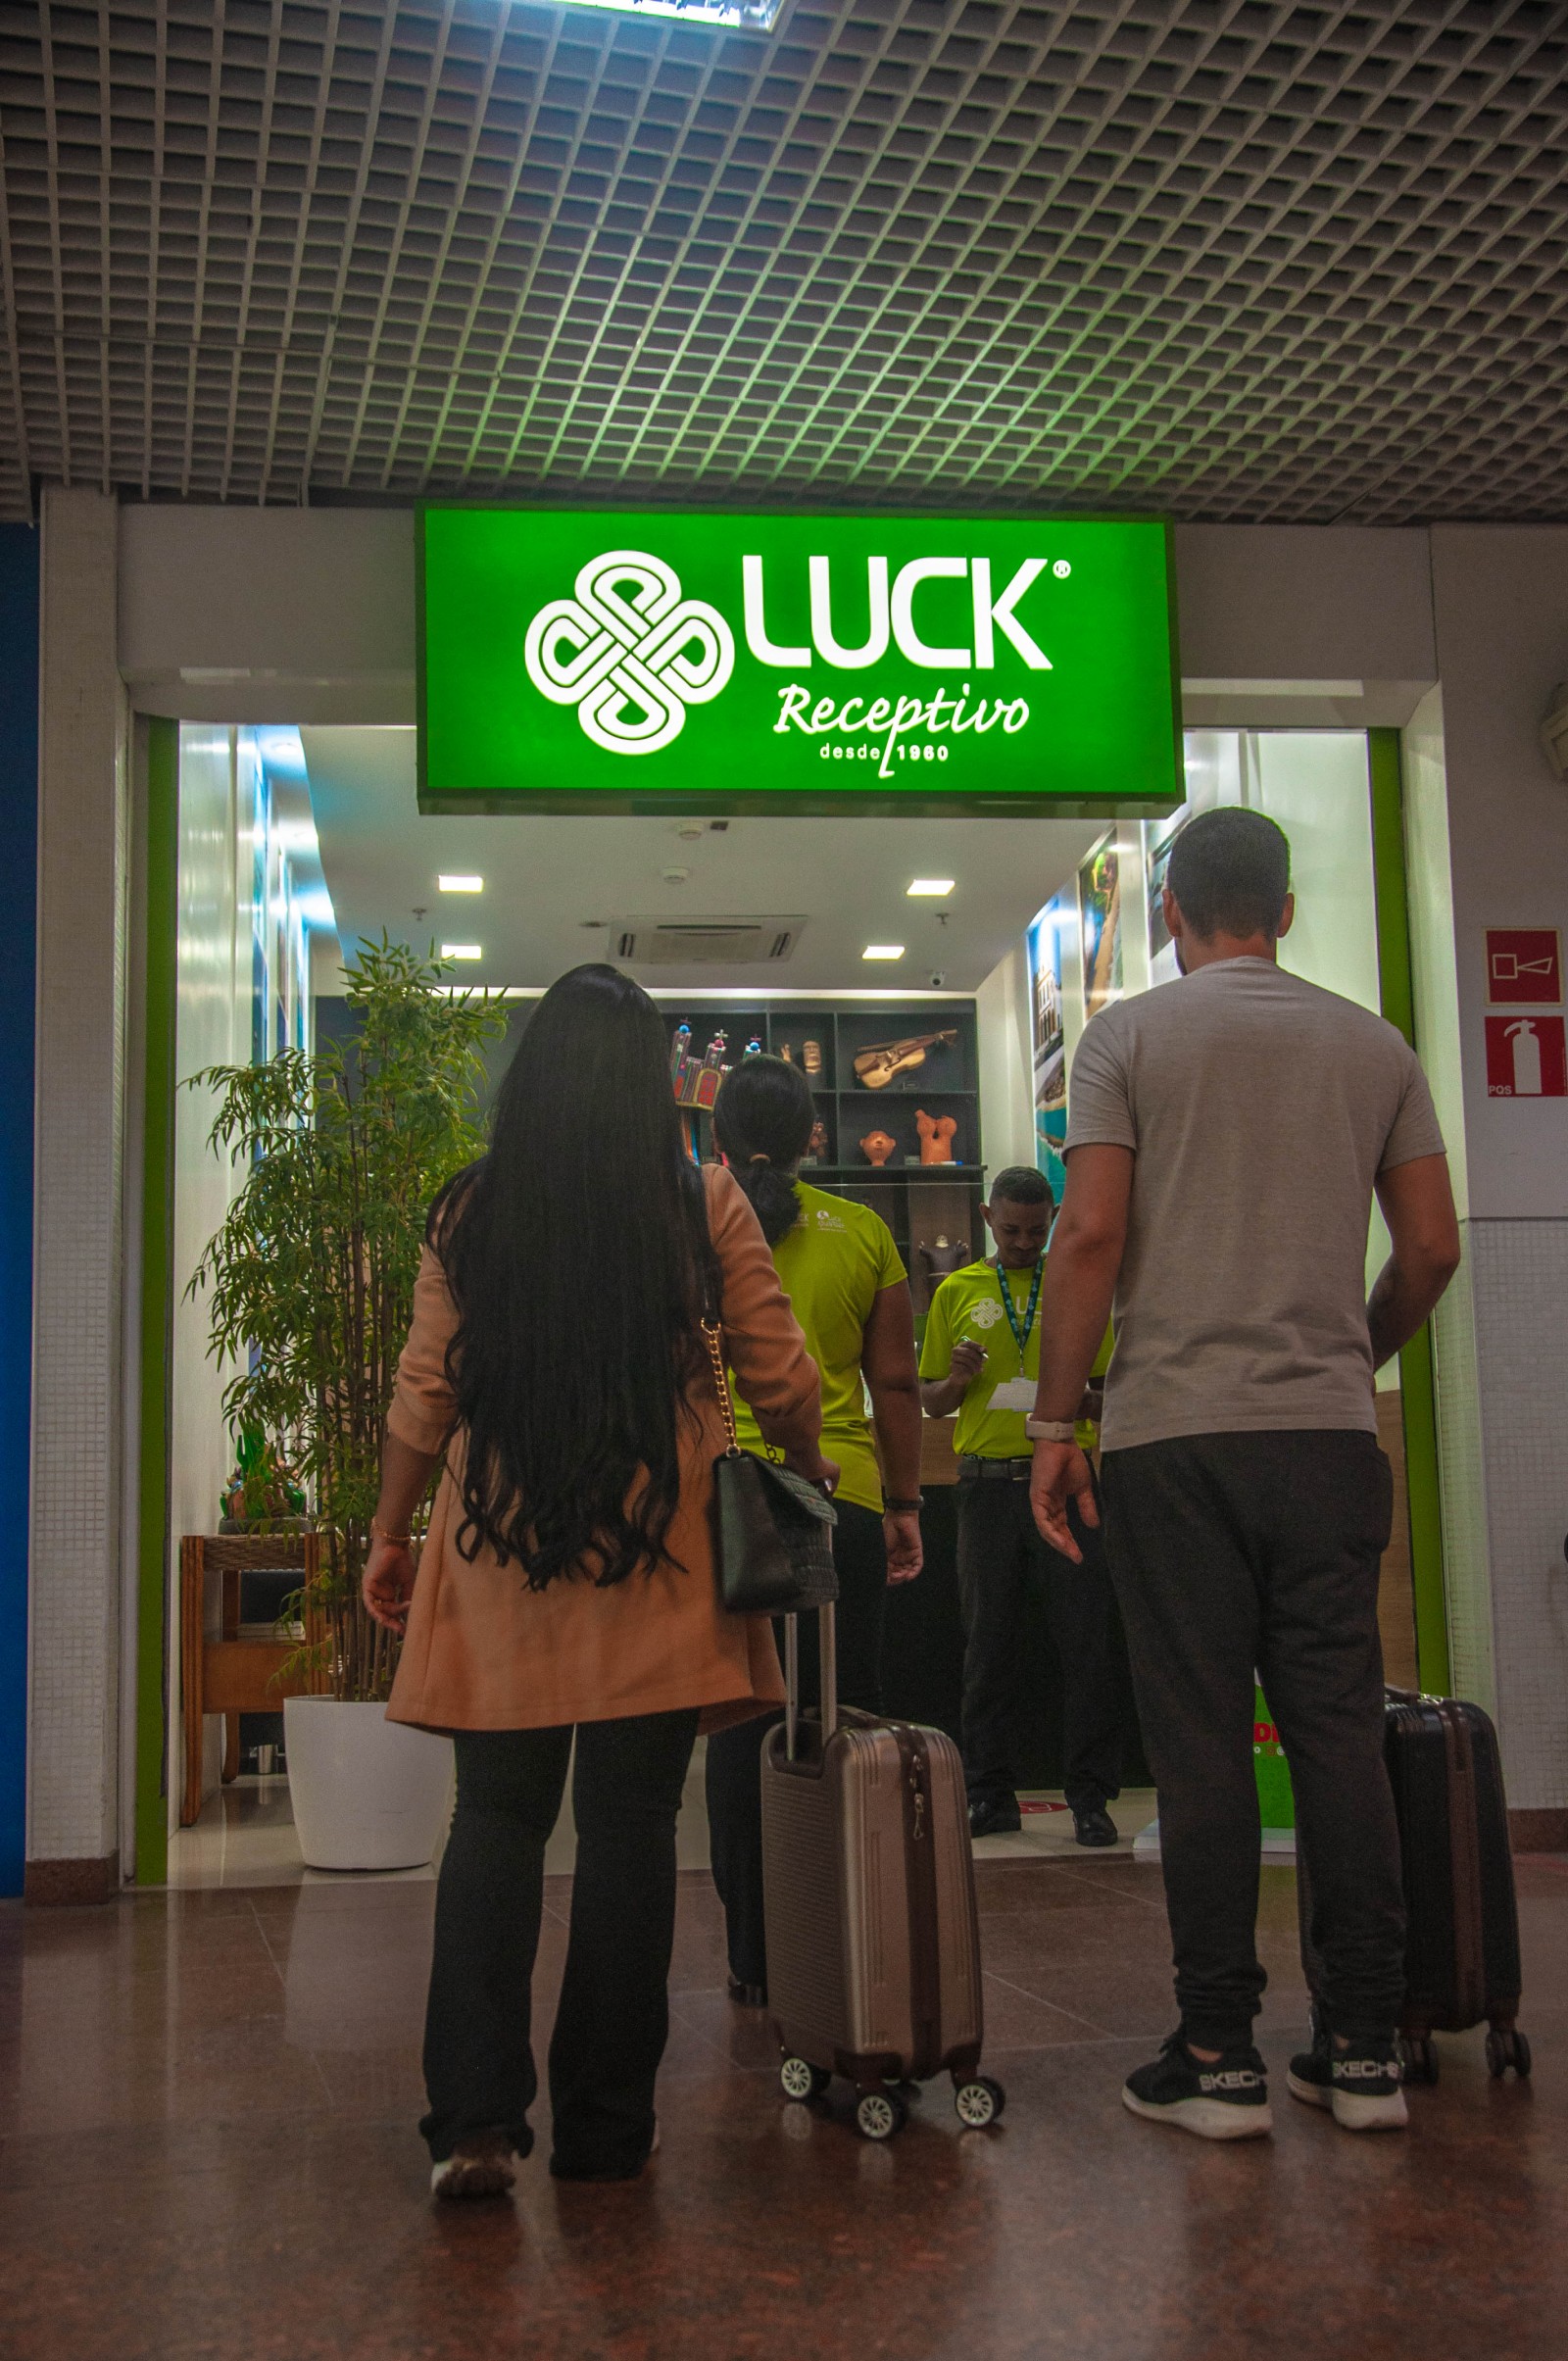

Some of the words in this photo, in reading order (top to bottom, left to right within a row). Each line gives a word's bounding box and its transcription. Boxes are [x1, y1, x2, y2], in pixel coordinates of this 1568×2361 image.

[772, 682, 1030, 779] Receptivo
[819, 742, 881, 761] desde
[896, 744, 949, 762] 1960
[1489, 1085, 1512, 1095] PQS
